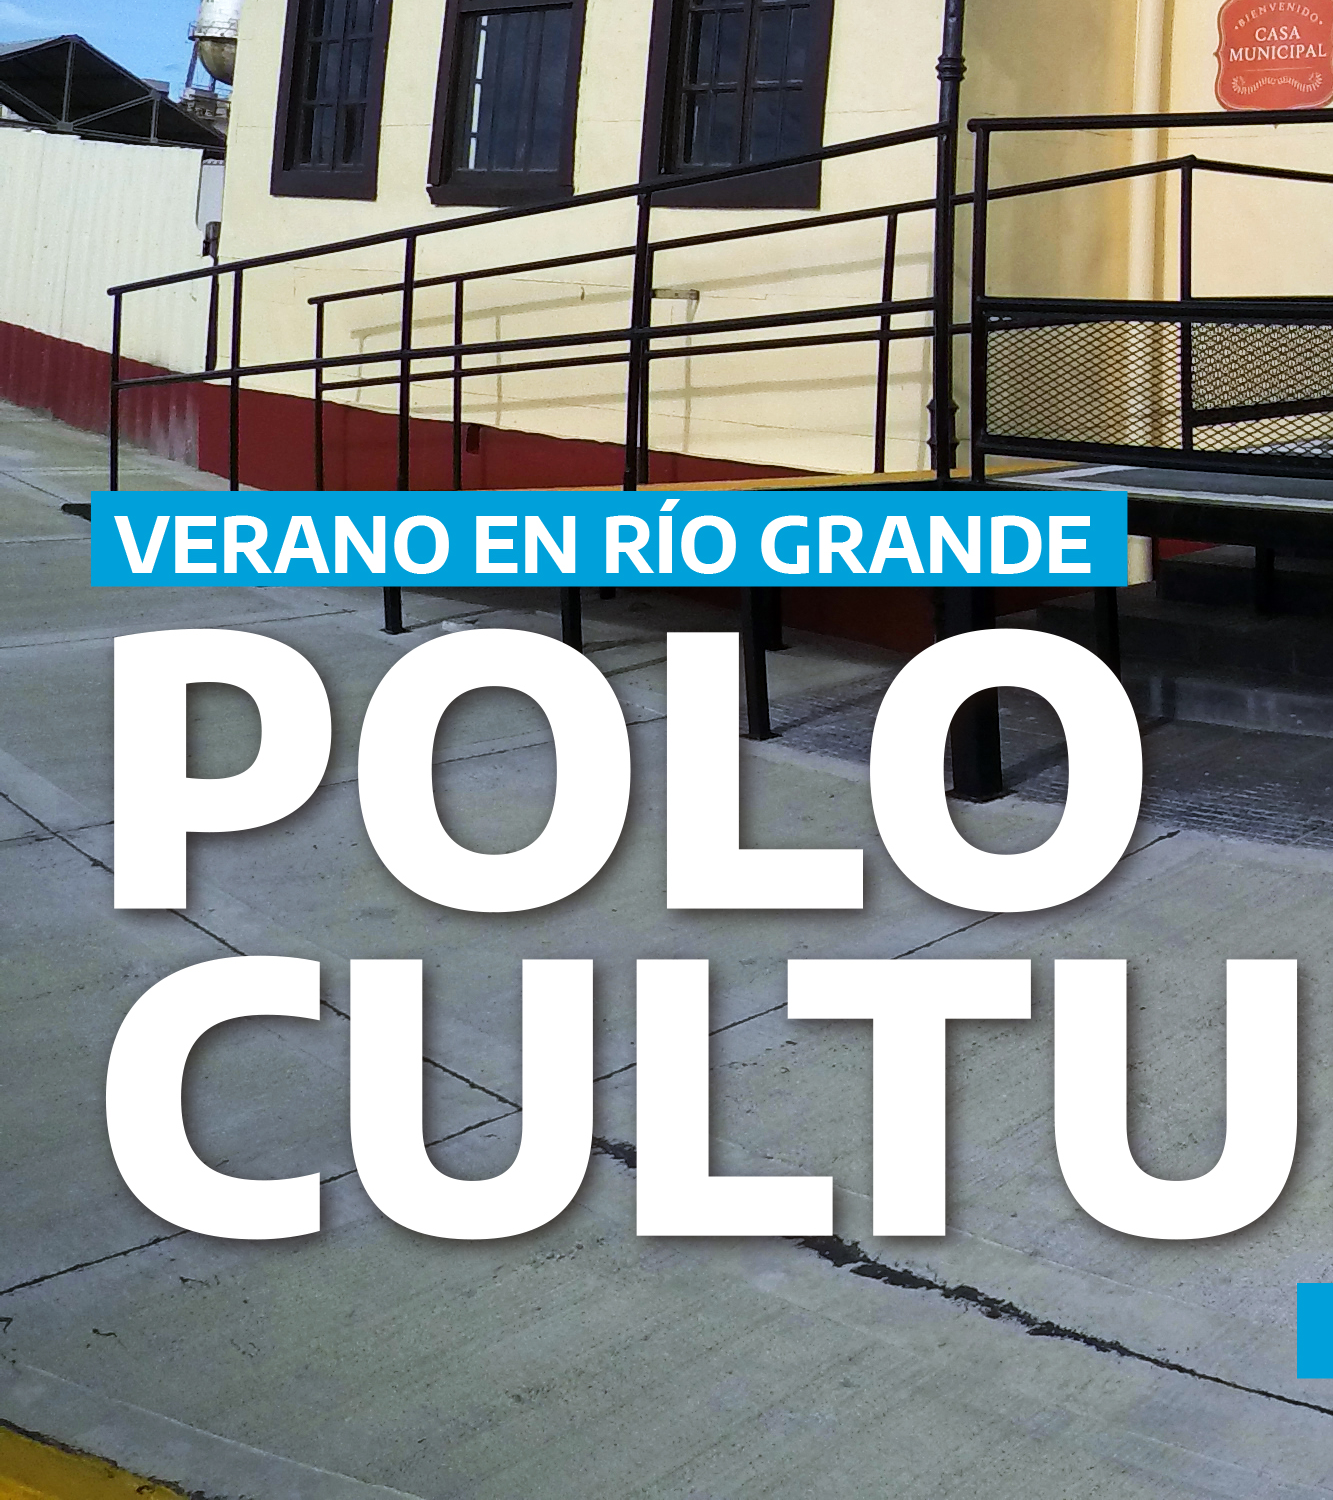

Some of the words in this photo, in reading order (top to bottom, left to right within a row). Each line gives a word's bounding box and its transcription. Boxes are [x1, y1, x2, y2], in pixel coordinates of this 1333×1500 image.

[1238, 2, 1319, 27] BIENVENIDO
[1255, 25, 1301, 42] CASA
[1229, 43, 1327, 62] MUNICIPAL
